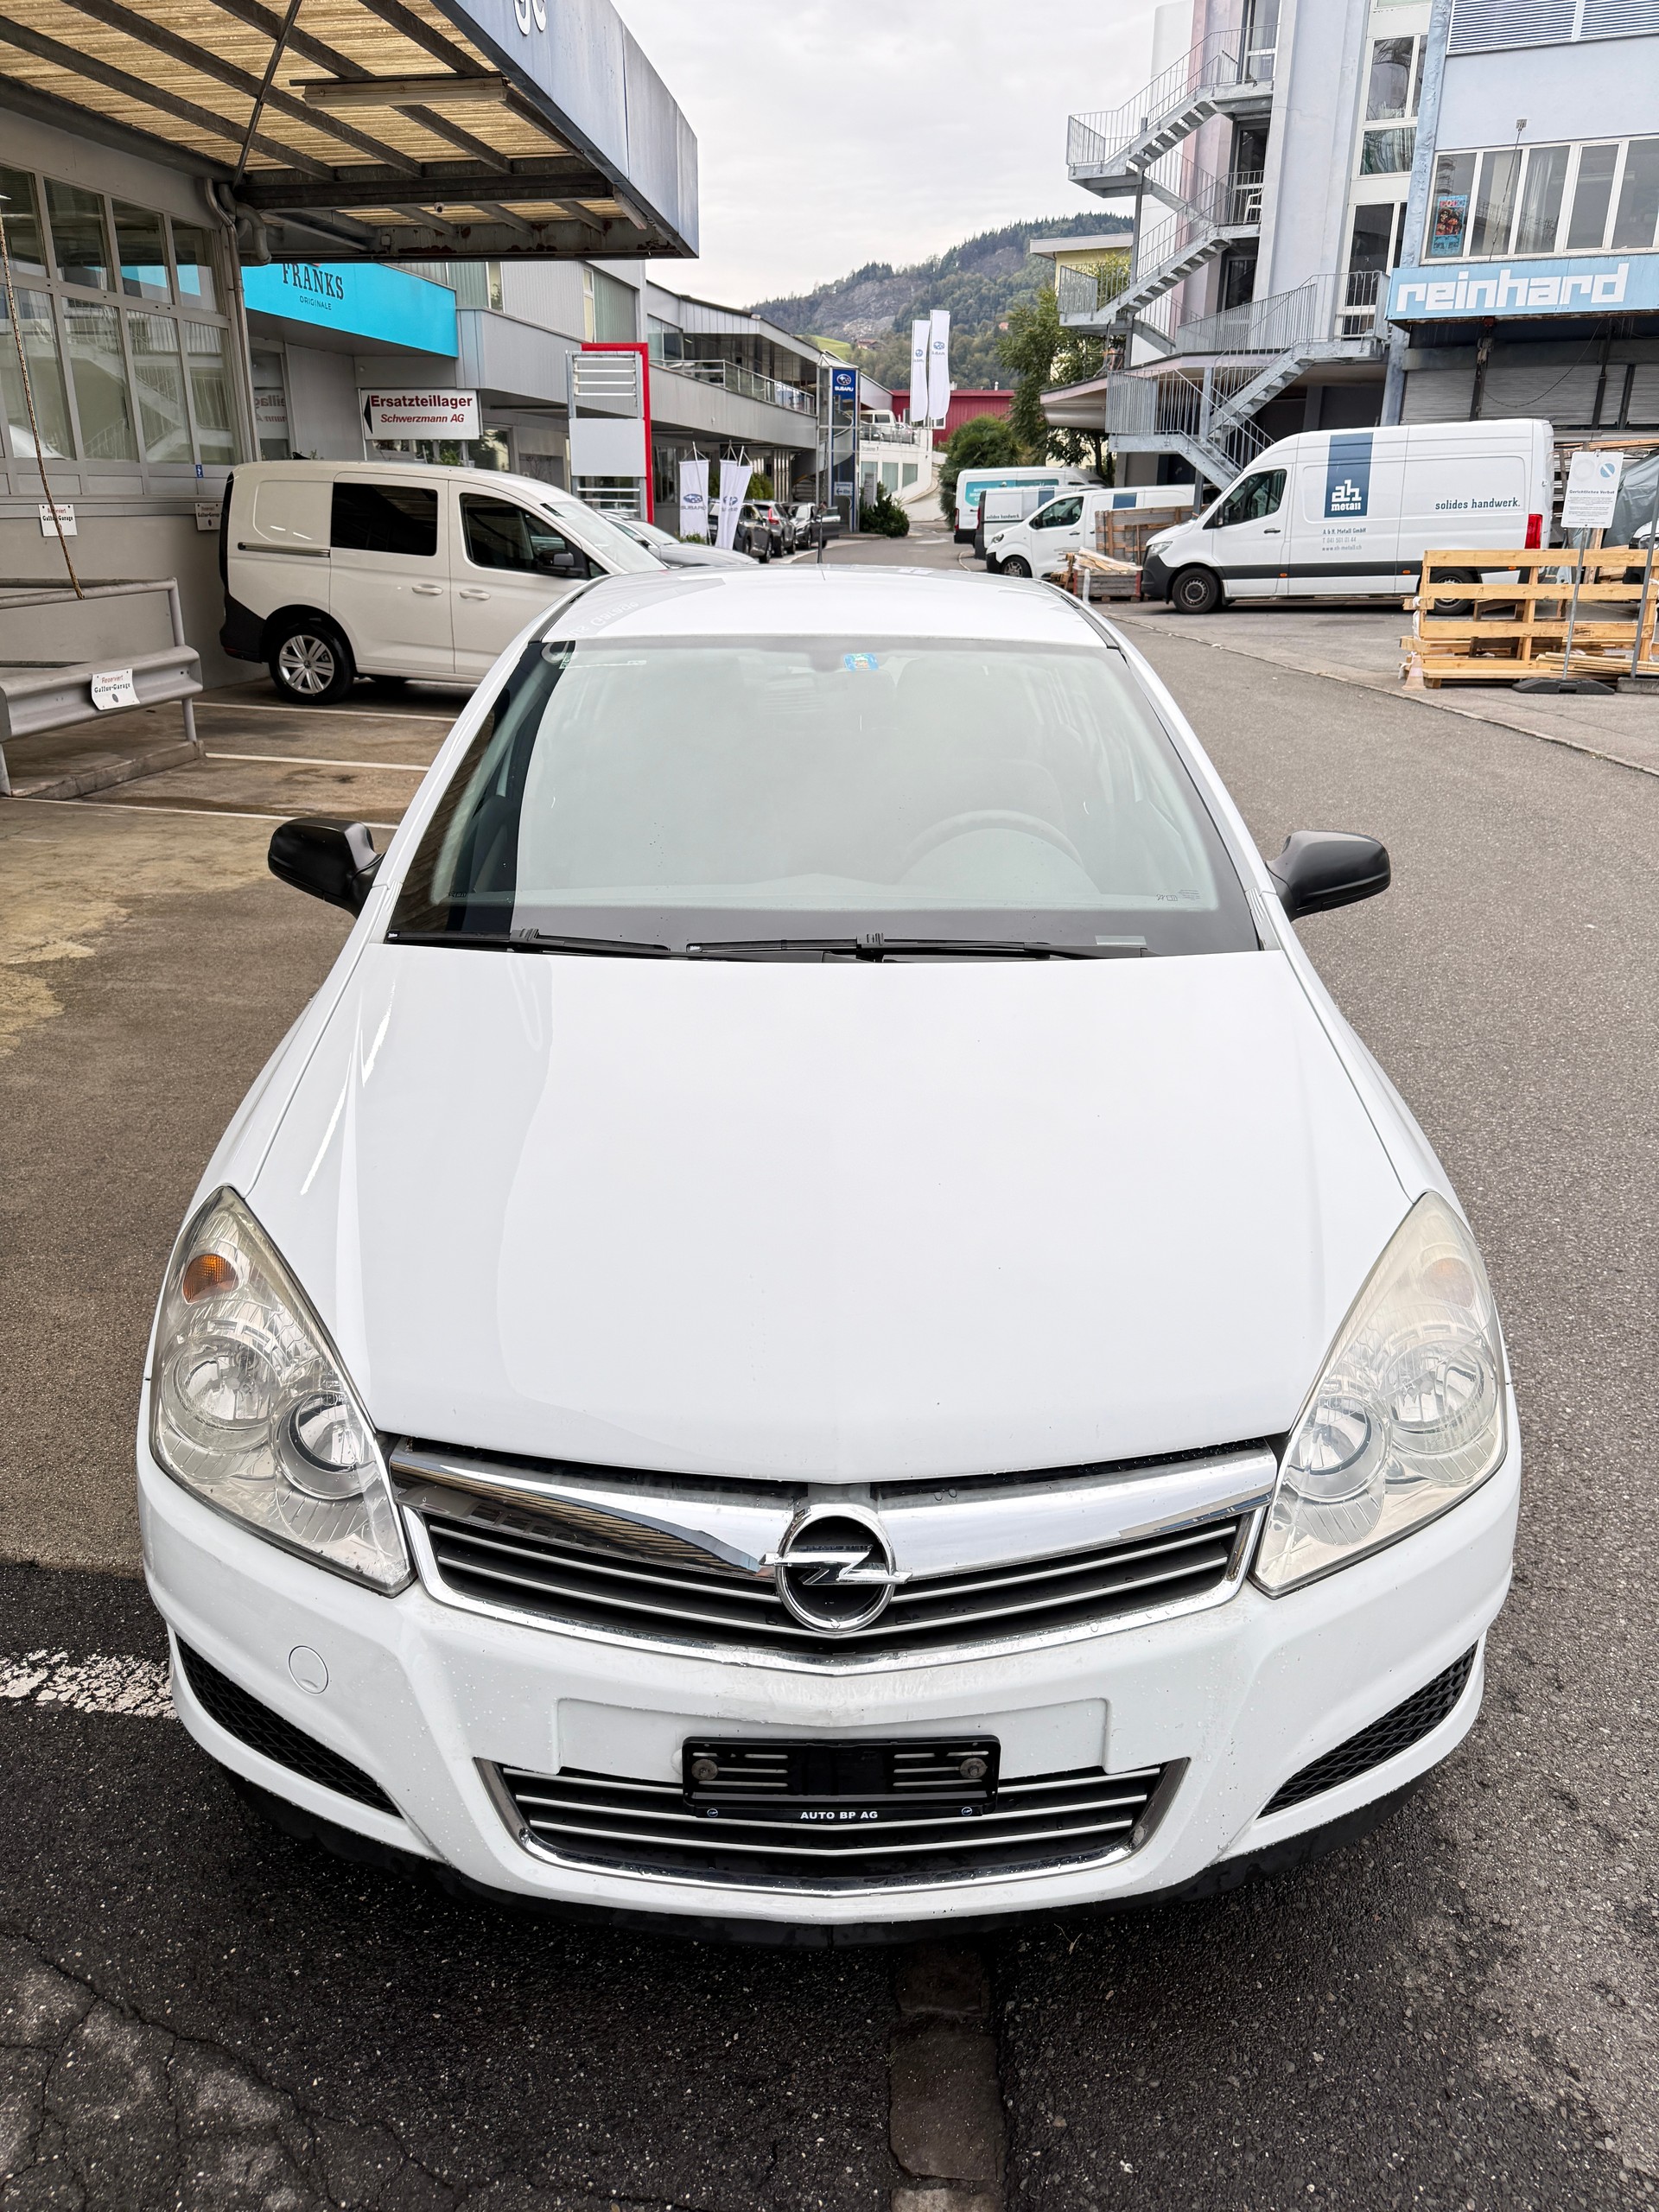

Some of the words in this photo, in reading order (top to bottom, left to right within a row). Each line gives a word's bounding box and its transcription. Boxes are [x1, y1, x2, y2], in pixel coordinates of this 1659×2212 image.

[283, 263, 344, 300] FRANKS
[1395, 262, 1630, 312] reinhard
[299, 296, 332, 311] ORIGINALE
[370, 395, 473, 409] Ersatzteillager
[380, 414, 448, 423] Schwerzmann
[450, 414, 465, 423] AG
[1332, 479, 1362, 502] ah
[1331, 502, 1361, 512] metall
[1435, 499, 1468, 510] solides
[1471, 497, 1521, 508] handwerk.
[94, 683, 130, 693] Gallus-Garage
[800, 1811, 835, 1820] AUTO
[839, 1811, 856, 1820] BP
[860, 1810, 878, 1819] AG
